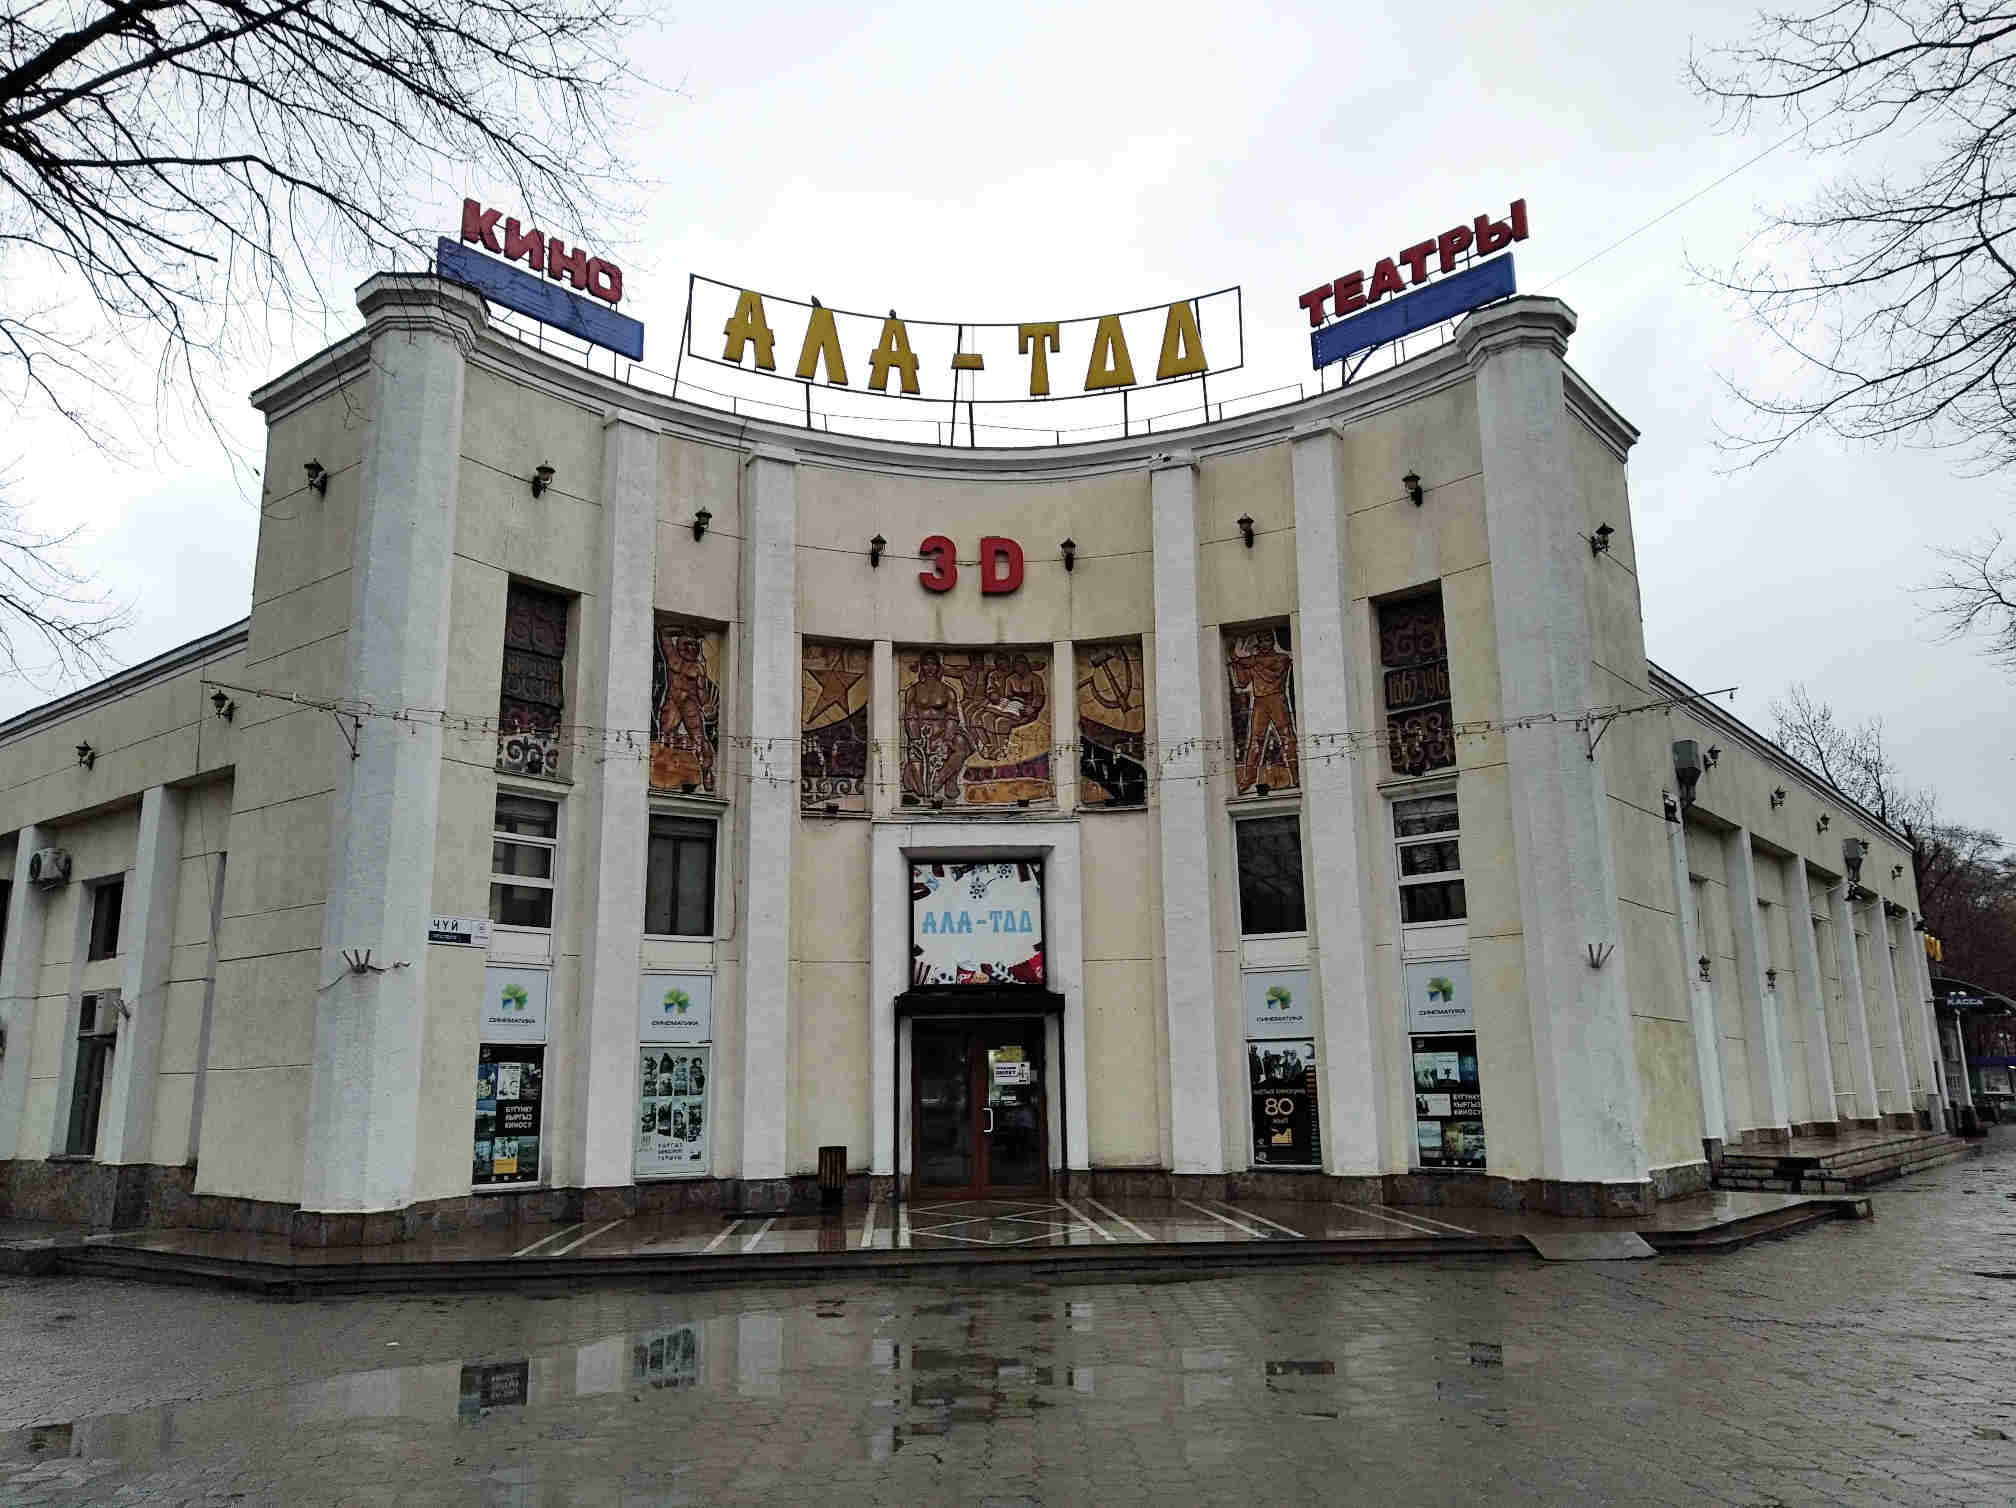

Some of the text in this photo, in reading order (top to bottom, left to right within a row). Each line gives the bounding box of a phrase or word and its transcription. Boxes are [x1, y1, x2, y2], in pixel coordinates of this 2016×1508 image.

[462, 197, 623, 304] КИНО
[1299, 198, 1529, 328] ТЕАТРЫ
[919, 535, 1024, 596] 3D
[1947, 999, 1984, 1007] КАССА
[1265, 1097, 1294, 1115] 80
